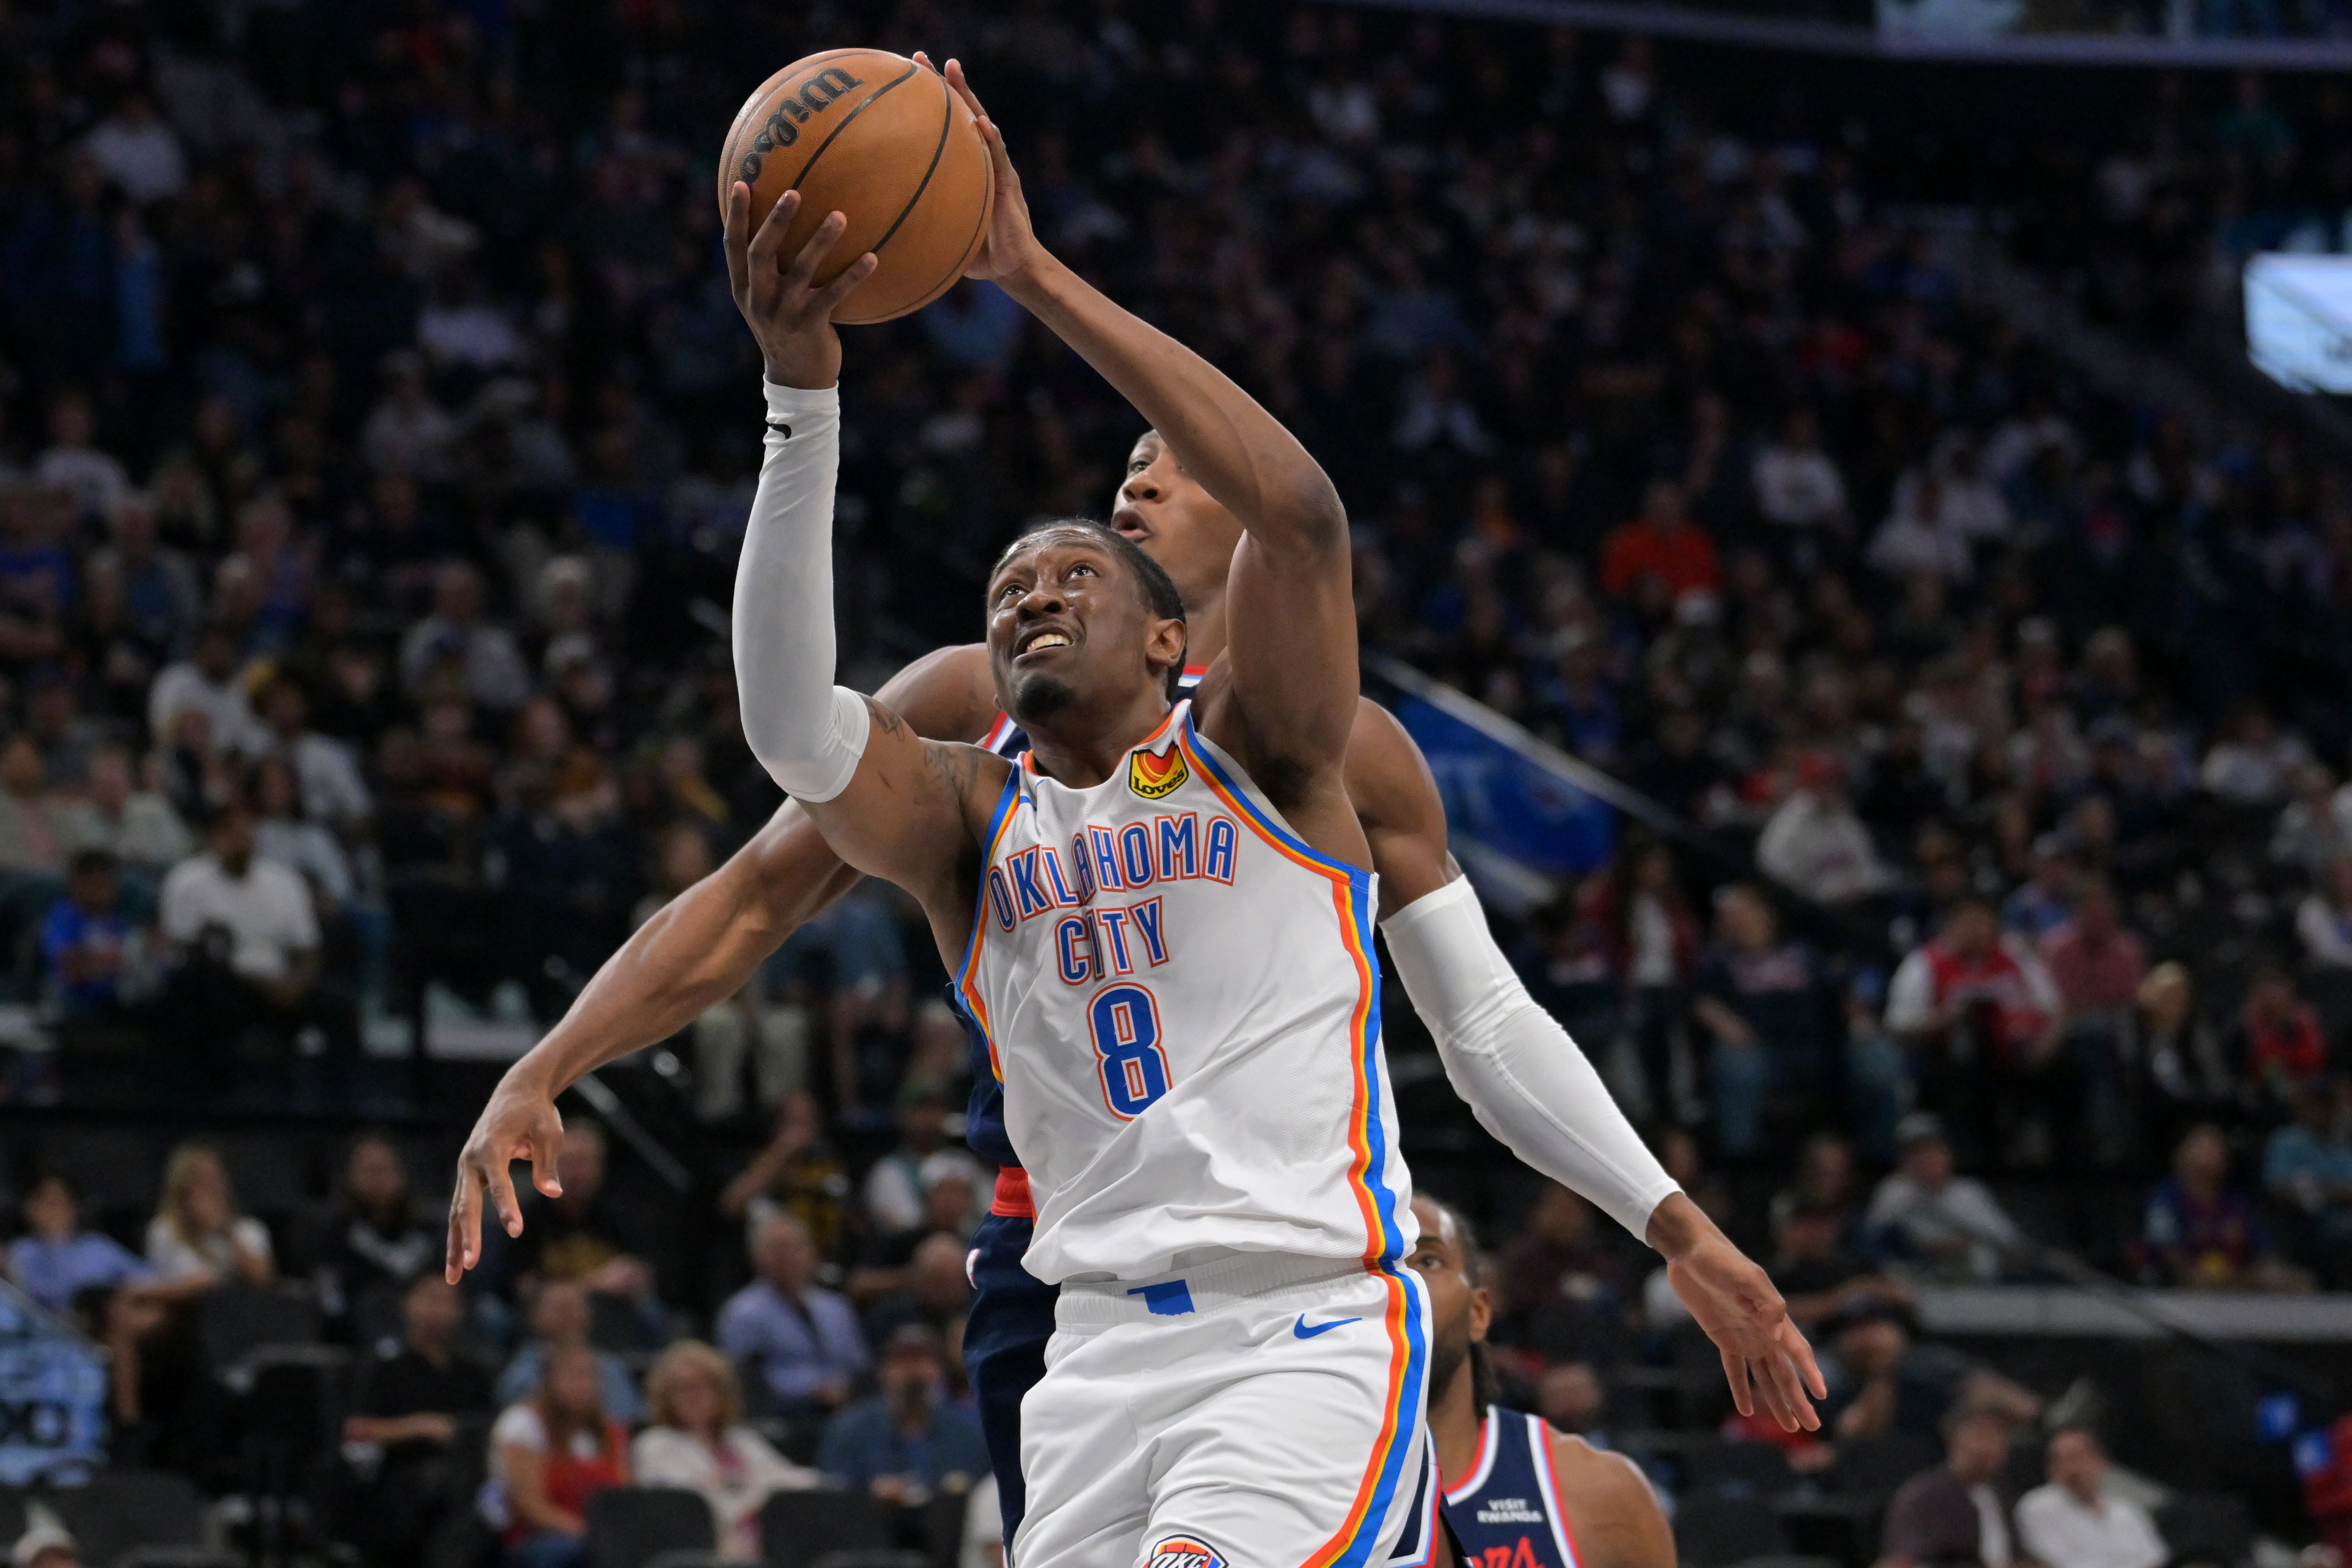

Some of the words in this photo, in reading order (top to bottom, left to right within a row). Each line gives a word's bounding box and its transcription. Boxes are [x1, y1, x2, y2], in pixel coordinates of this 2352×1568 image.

[741, 68, 865, 189] Wilso
[988, 811, 1239, 933] OKLAHOMA
[1055, 895, 1169, 986] CITY
[1087, 982, 1172, 1121] 8
[1476, 1510, 1543, 1523] RWANDA
[1488, 1498, 1527, 1511] VISIT
